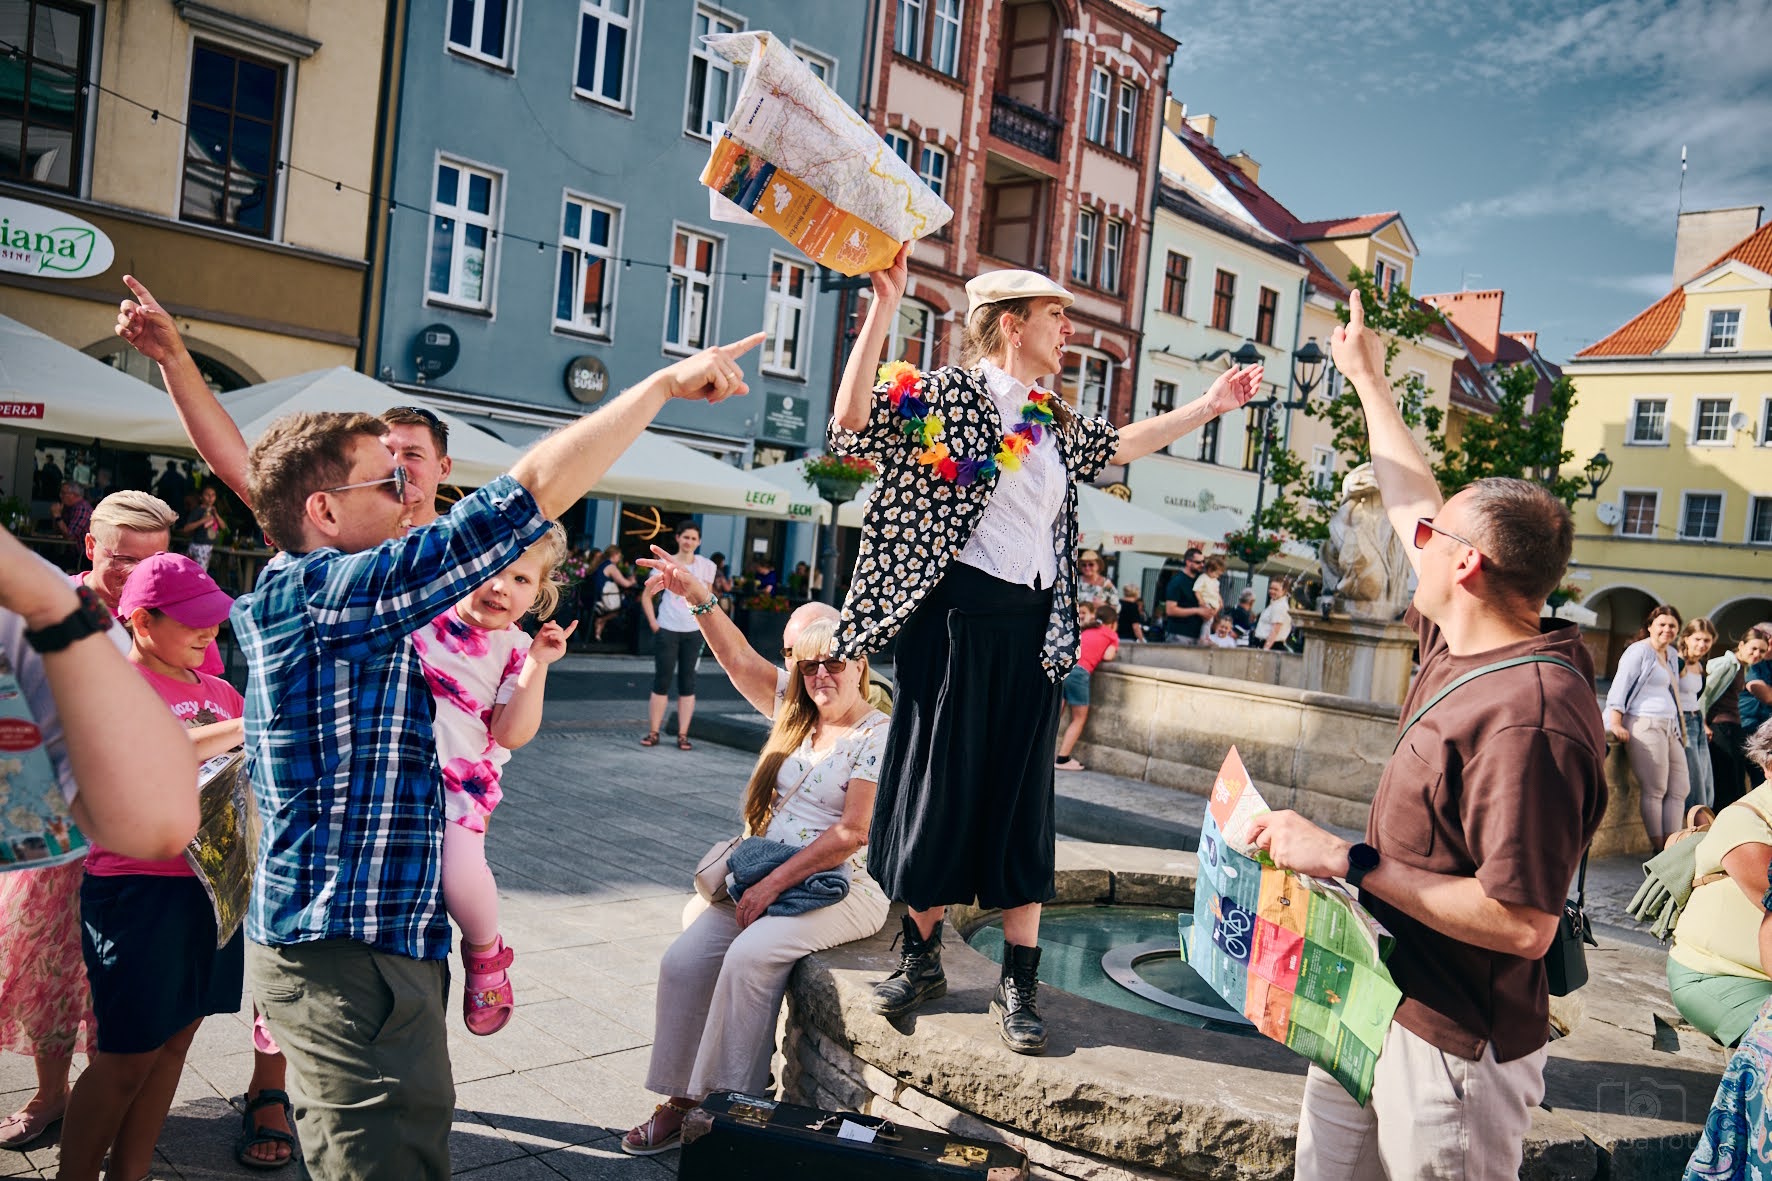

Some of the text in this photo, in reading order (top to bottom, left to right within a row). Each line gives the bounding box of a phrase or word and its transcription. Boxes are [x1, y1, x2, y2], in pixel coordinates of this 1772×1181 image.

[574, 367, 604, 380] KOKU
[574, 378, 604, 391] SUSHI
[745, 490, 776, 504] LECH
[1163, 495, 1196, 509] GALERIA
[788, 503, 812, 516] LECH
[1112, 535, 1134, 546] TYSKIE
